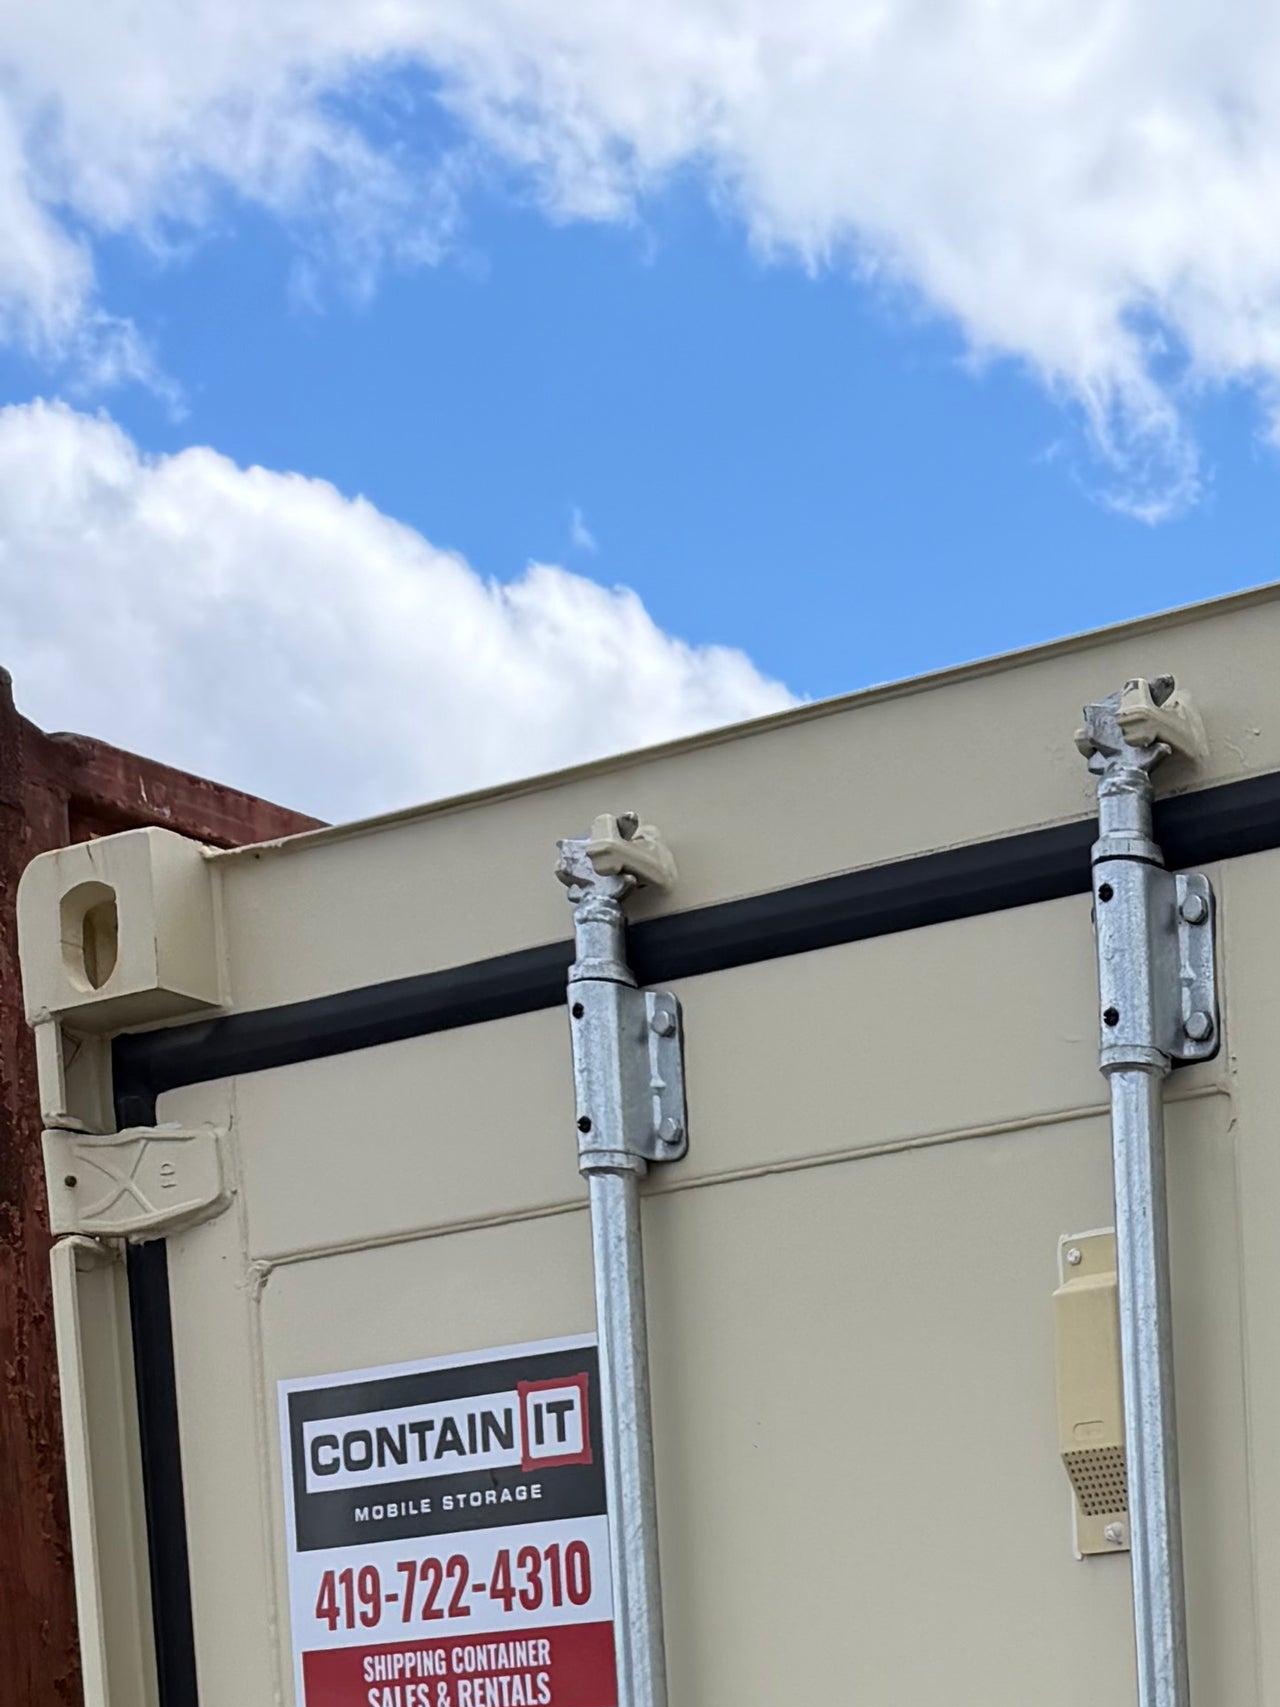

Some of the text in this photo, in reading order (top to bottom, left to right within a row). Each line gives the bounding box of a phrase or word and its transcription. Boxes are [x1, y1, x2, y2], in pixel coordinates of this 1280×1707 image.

[354, 1484, 543, 1522] MOBILE STORAGE
[315, 1540, 593, 1631] 419-722-4310
[363, 1639, 552, 1683] SHIPPING CONTAINER
